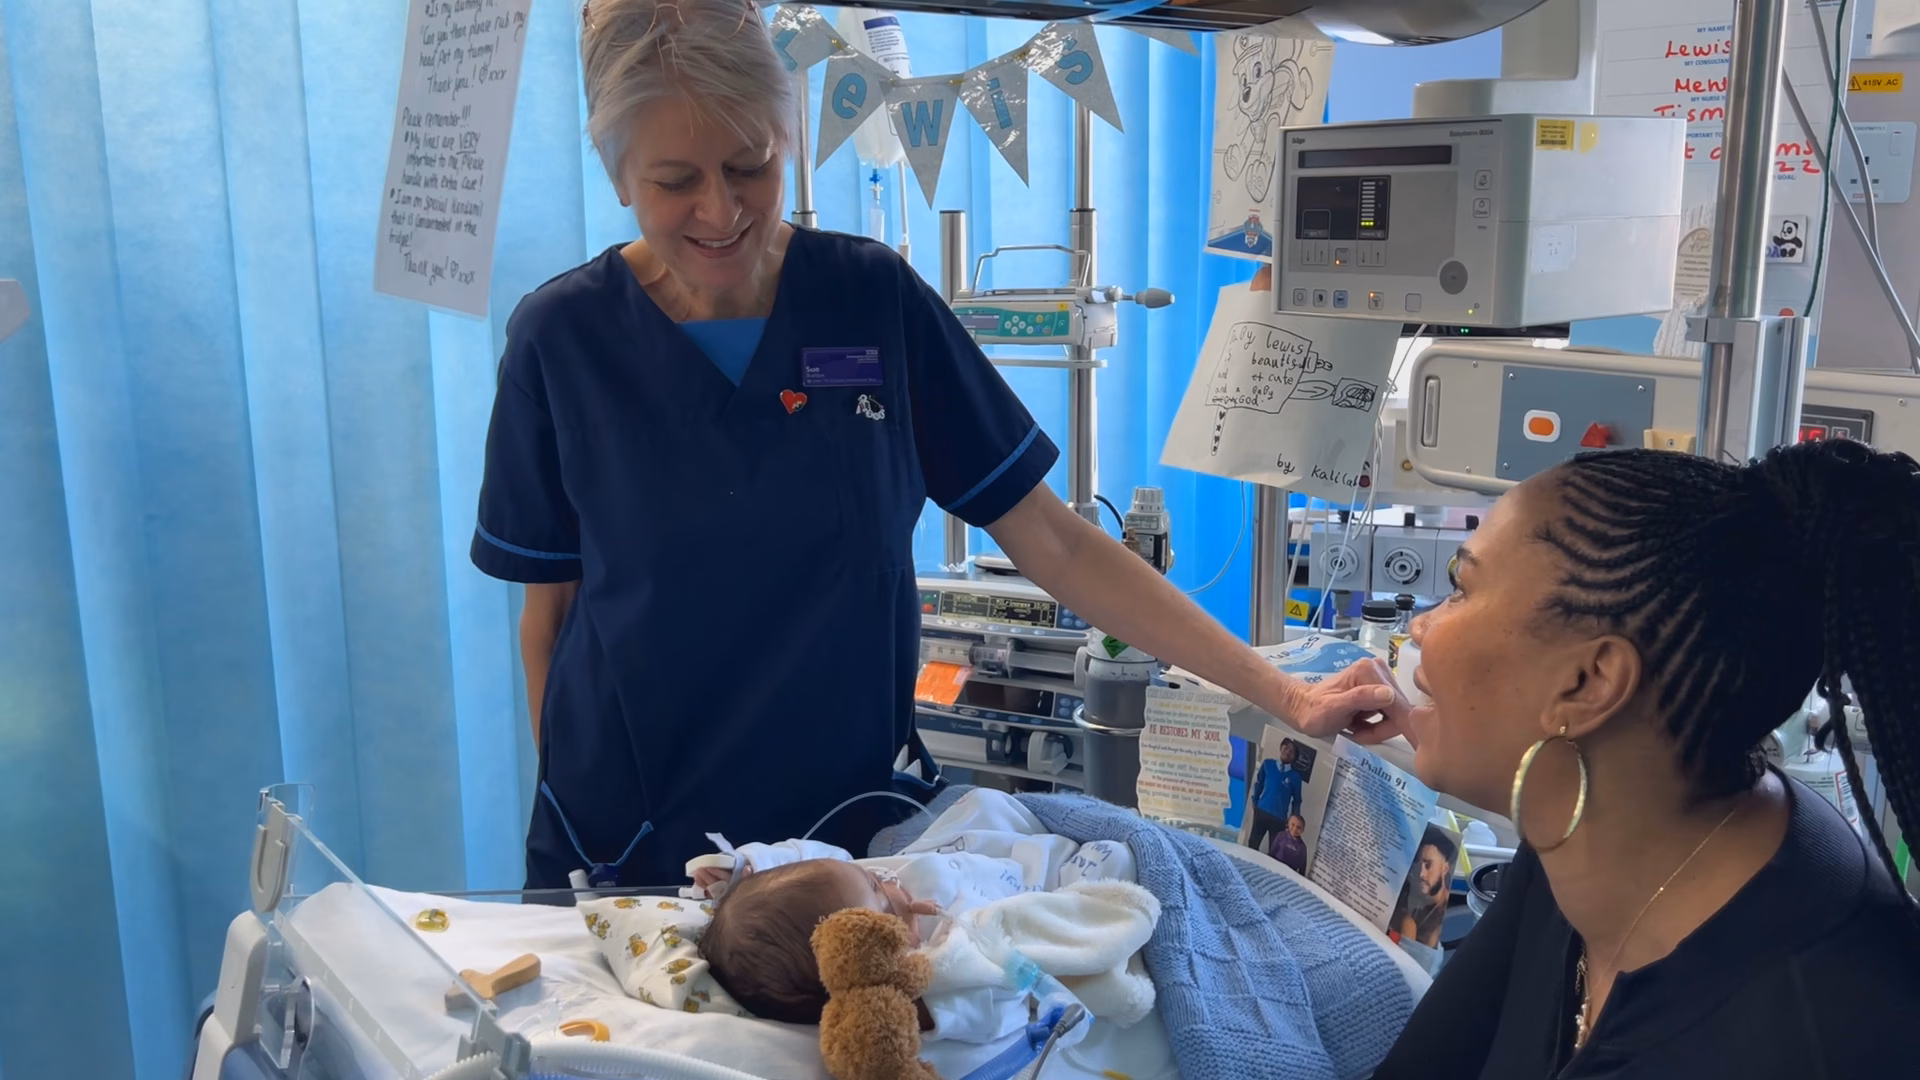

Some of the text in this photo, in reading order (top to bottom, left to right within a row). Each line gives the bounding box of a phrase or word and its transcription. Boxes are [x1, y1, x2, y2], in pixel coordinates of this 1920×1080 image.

[1277, 453, 1296, 474] by
[1360, 757, 1407, 790] Psalm 91
